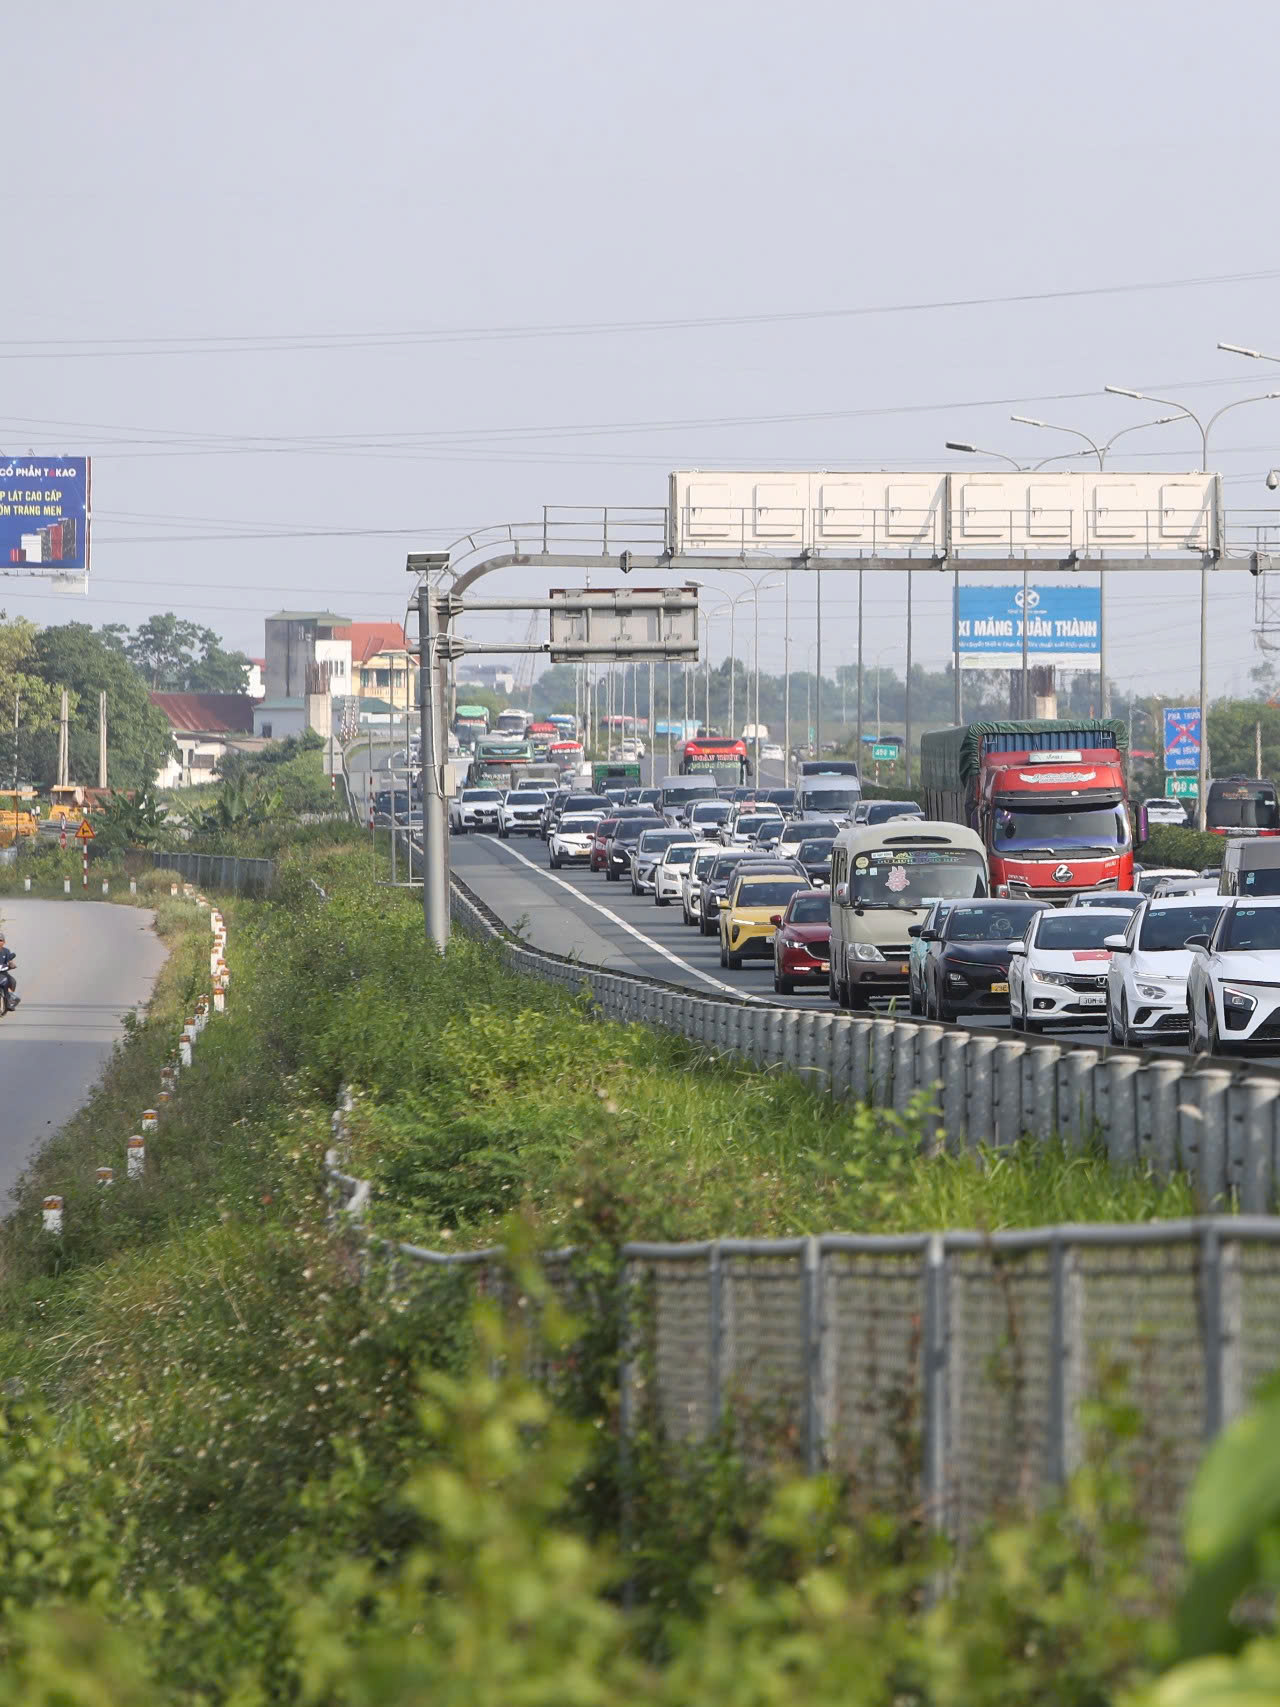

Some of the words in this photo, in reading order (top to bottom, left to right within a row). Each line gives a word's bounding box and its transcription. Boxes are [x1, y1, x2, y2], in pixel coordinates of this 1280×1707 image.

[25, 490, 42, 502] CAO
[43, 504, 62, 516] MEN
[958, 620, 970, 637] XI
[974, 615, 1013, 637] MĂNG
[1055, 616, 1097, 637] THÀNH
